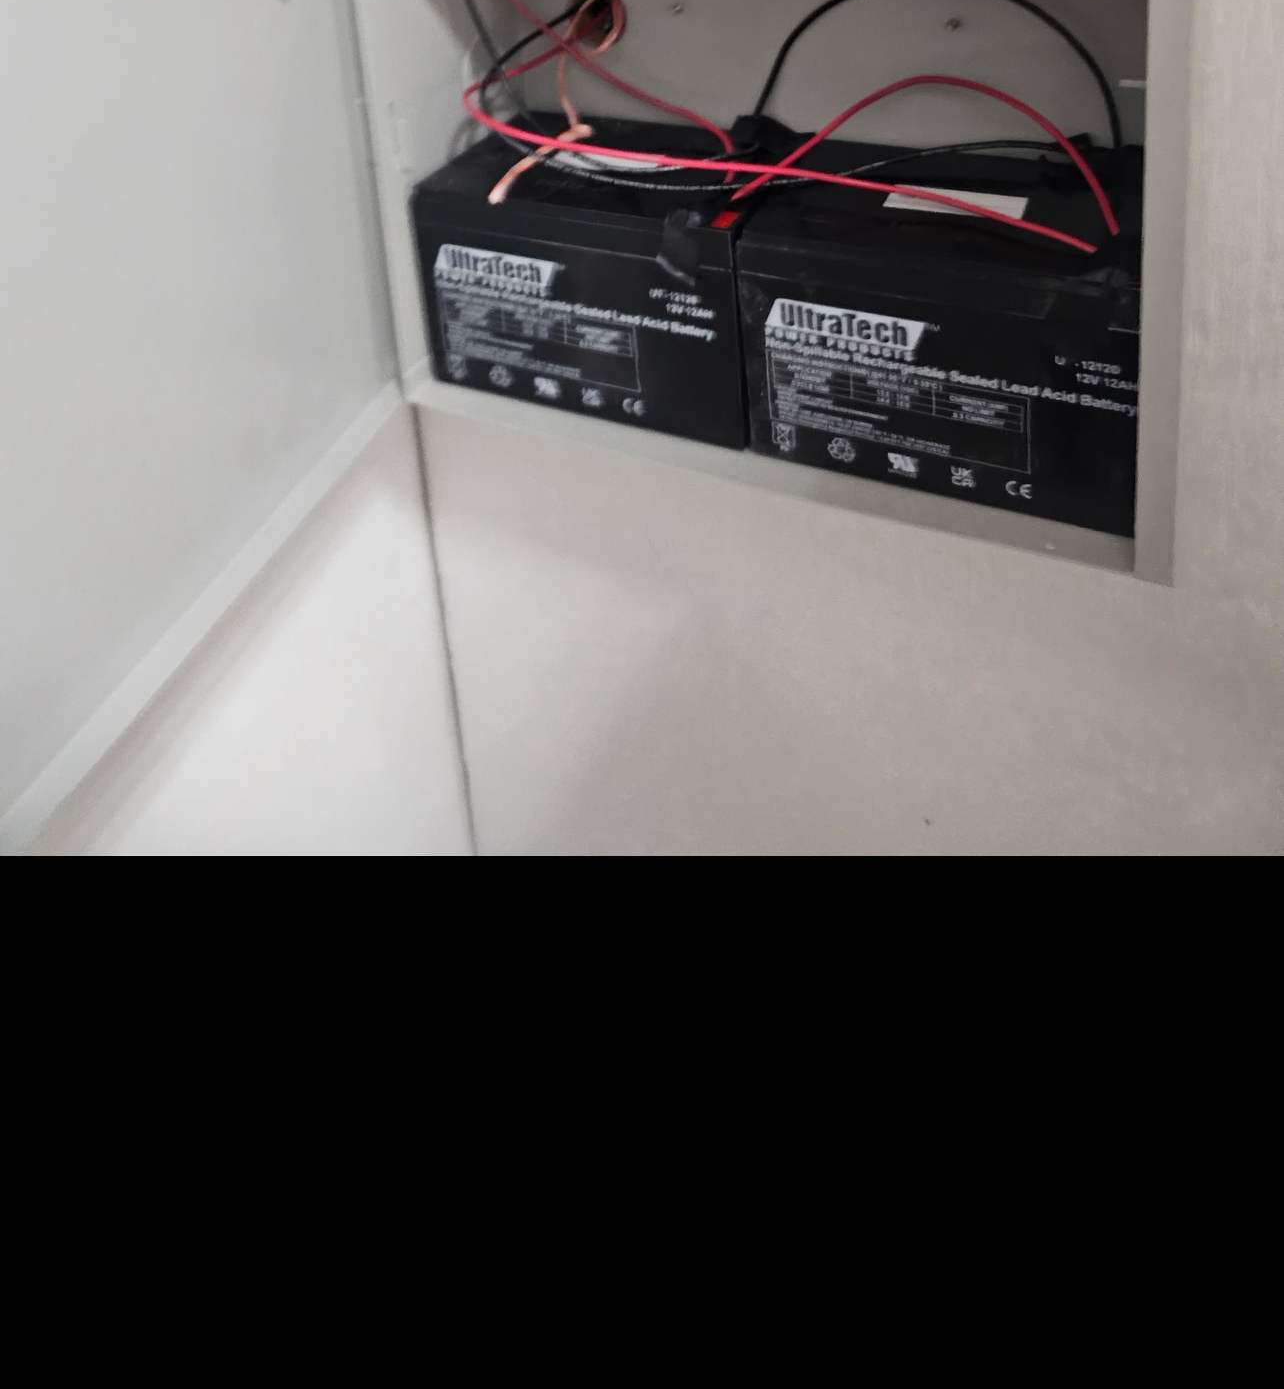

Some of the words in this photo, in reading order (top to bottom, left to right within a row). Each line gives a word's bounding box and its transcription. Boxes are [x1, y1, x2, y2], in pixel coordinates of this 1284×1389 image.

[780, 302, 908, 347] UltraTech
[949, 369, 999, 390] Sealed
[1000, 379, 1040, 397] Lead
[1041, 386, 1079, 404] Acid
[1079, 394, 1138, 417] Battery
[1075, 373, 1100, 385] 12V
[1005, 480, 1033, 499] CE
